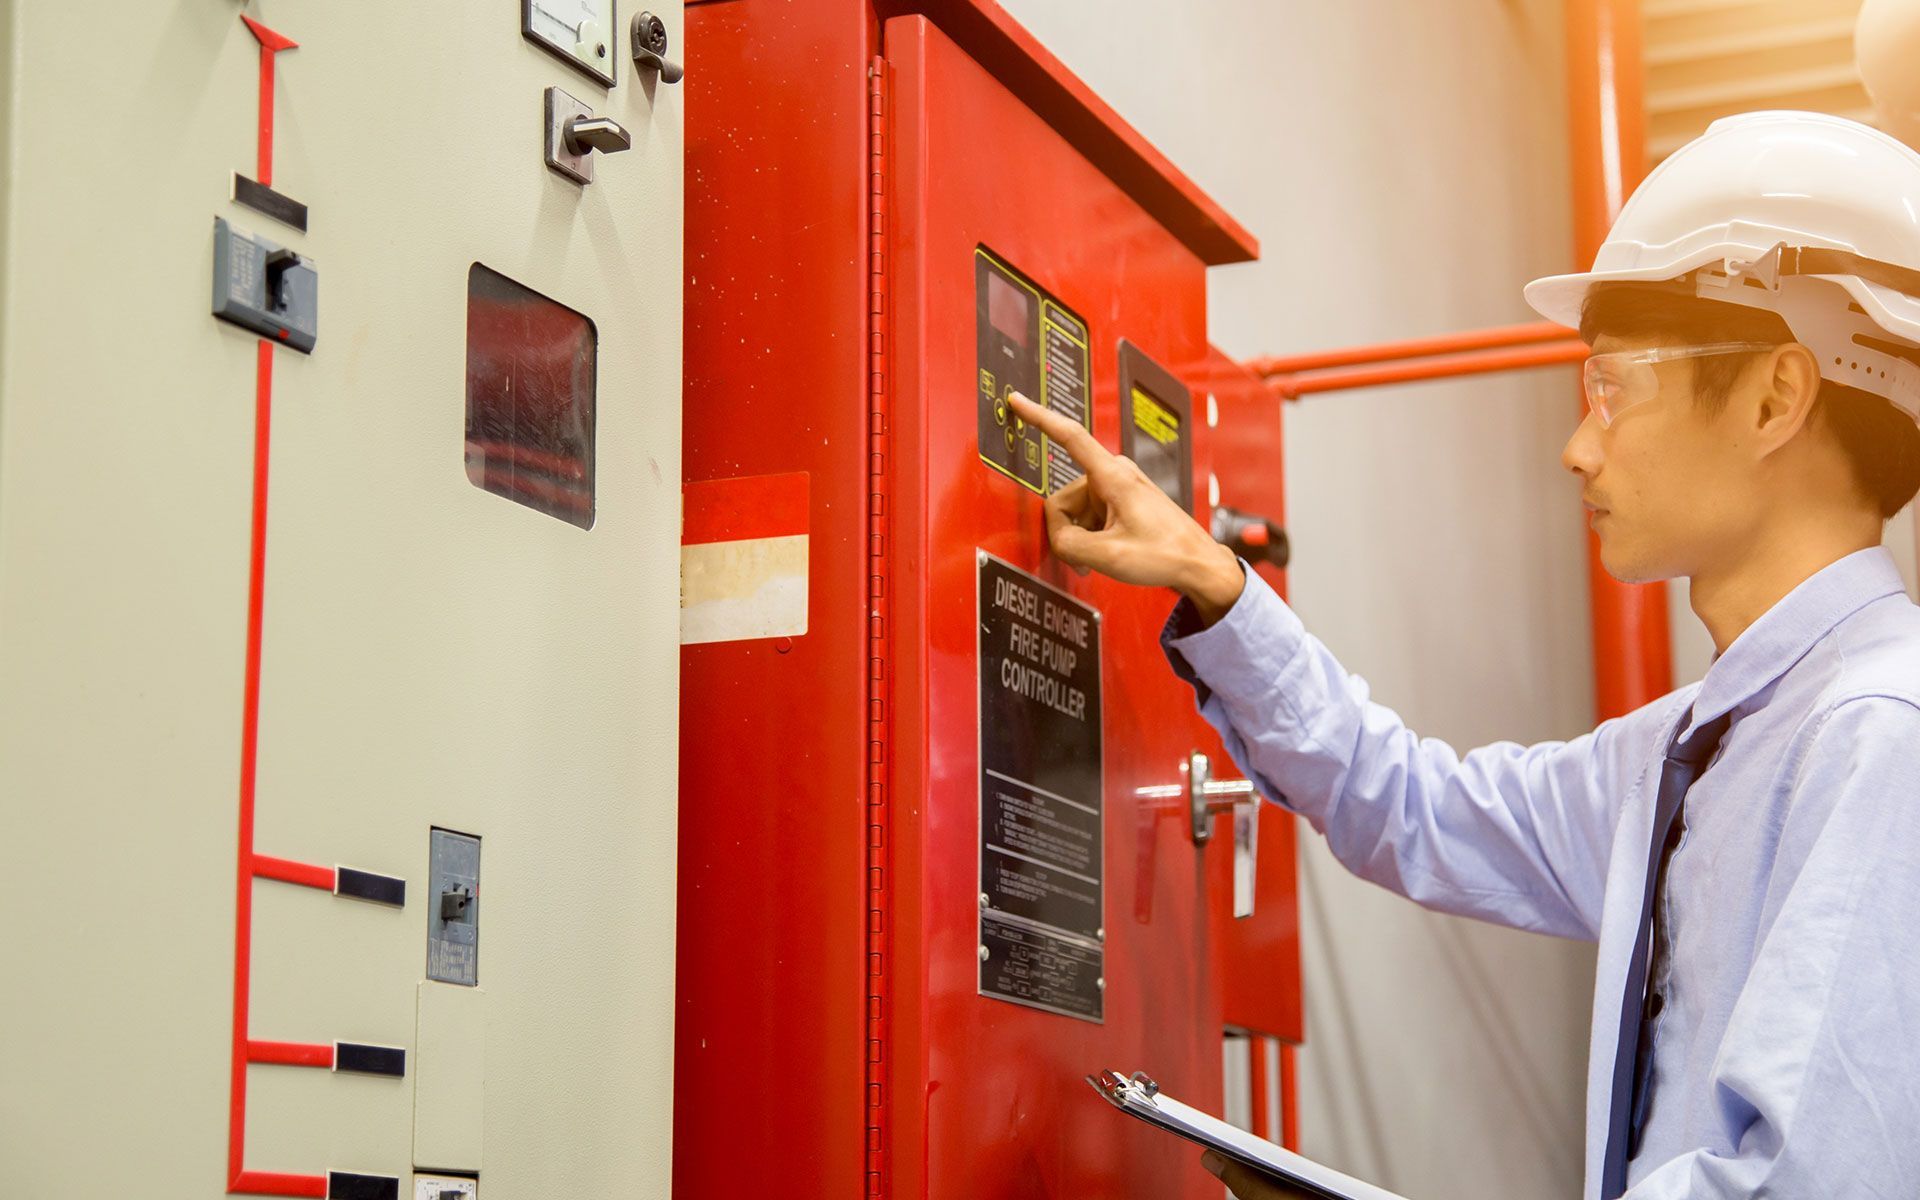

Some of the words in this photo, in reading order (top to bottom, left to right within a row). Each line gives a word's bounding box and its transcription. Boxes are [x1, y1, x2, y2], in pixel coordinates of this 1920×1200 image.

[995, 577, 1041, 625] DIESEL
[1043, 601, 1088, 649] ENGINE
[1010, 623, 1039, 663] FIRE
[1041, 639, 1077, 678] PUMP
[1001, 657, 1086, 722] CONTROLLER
